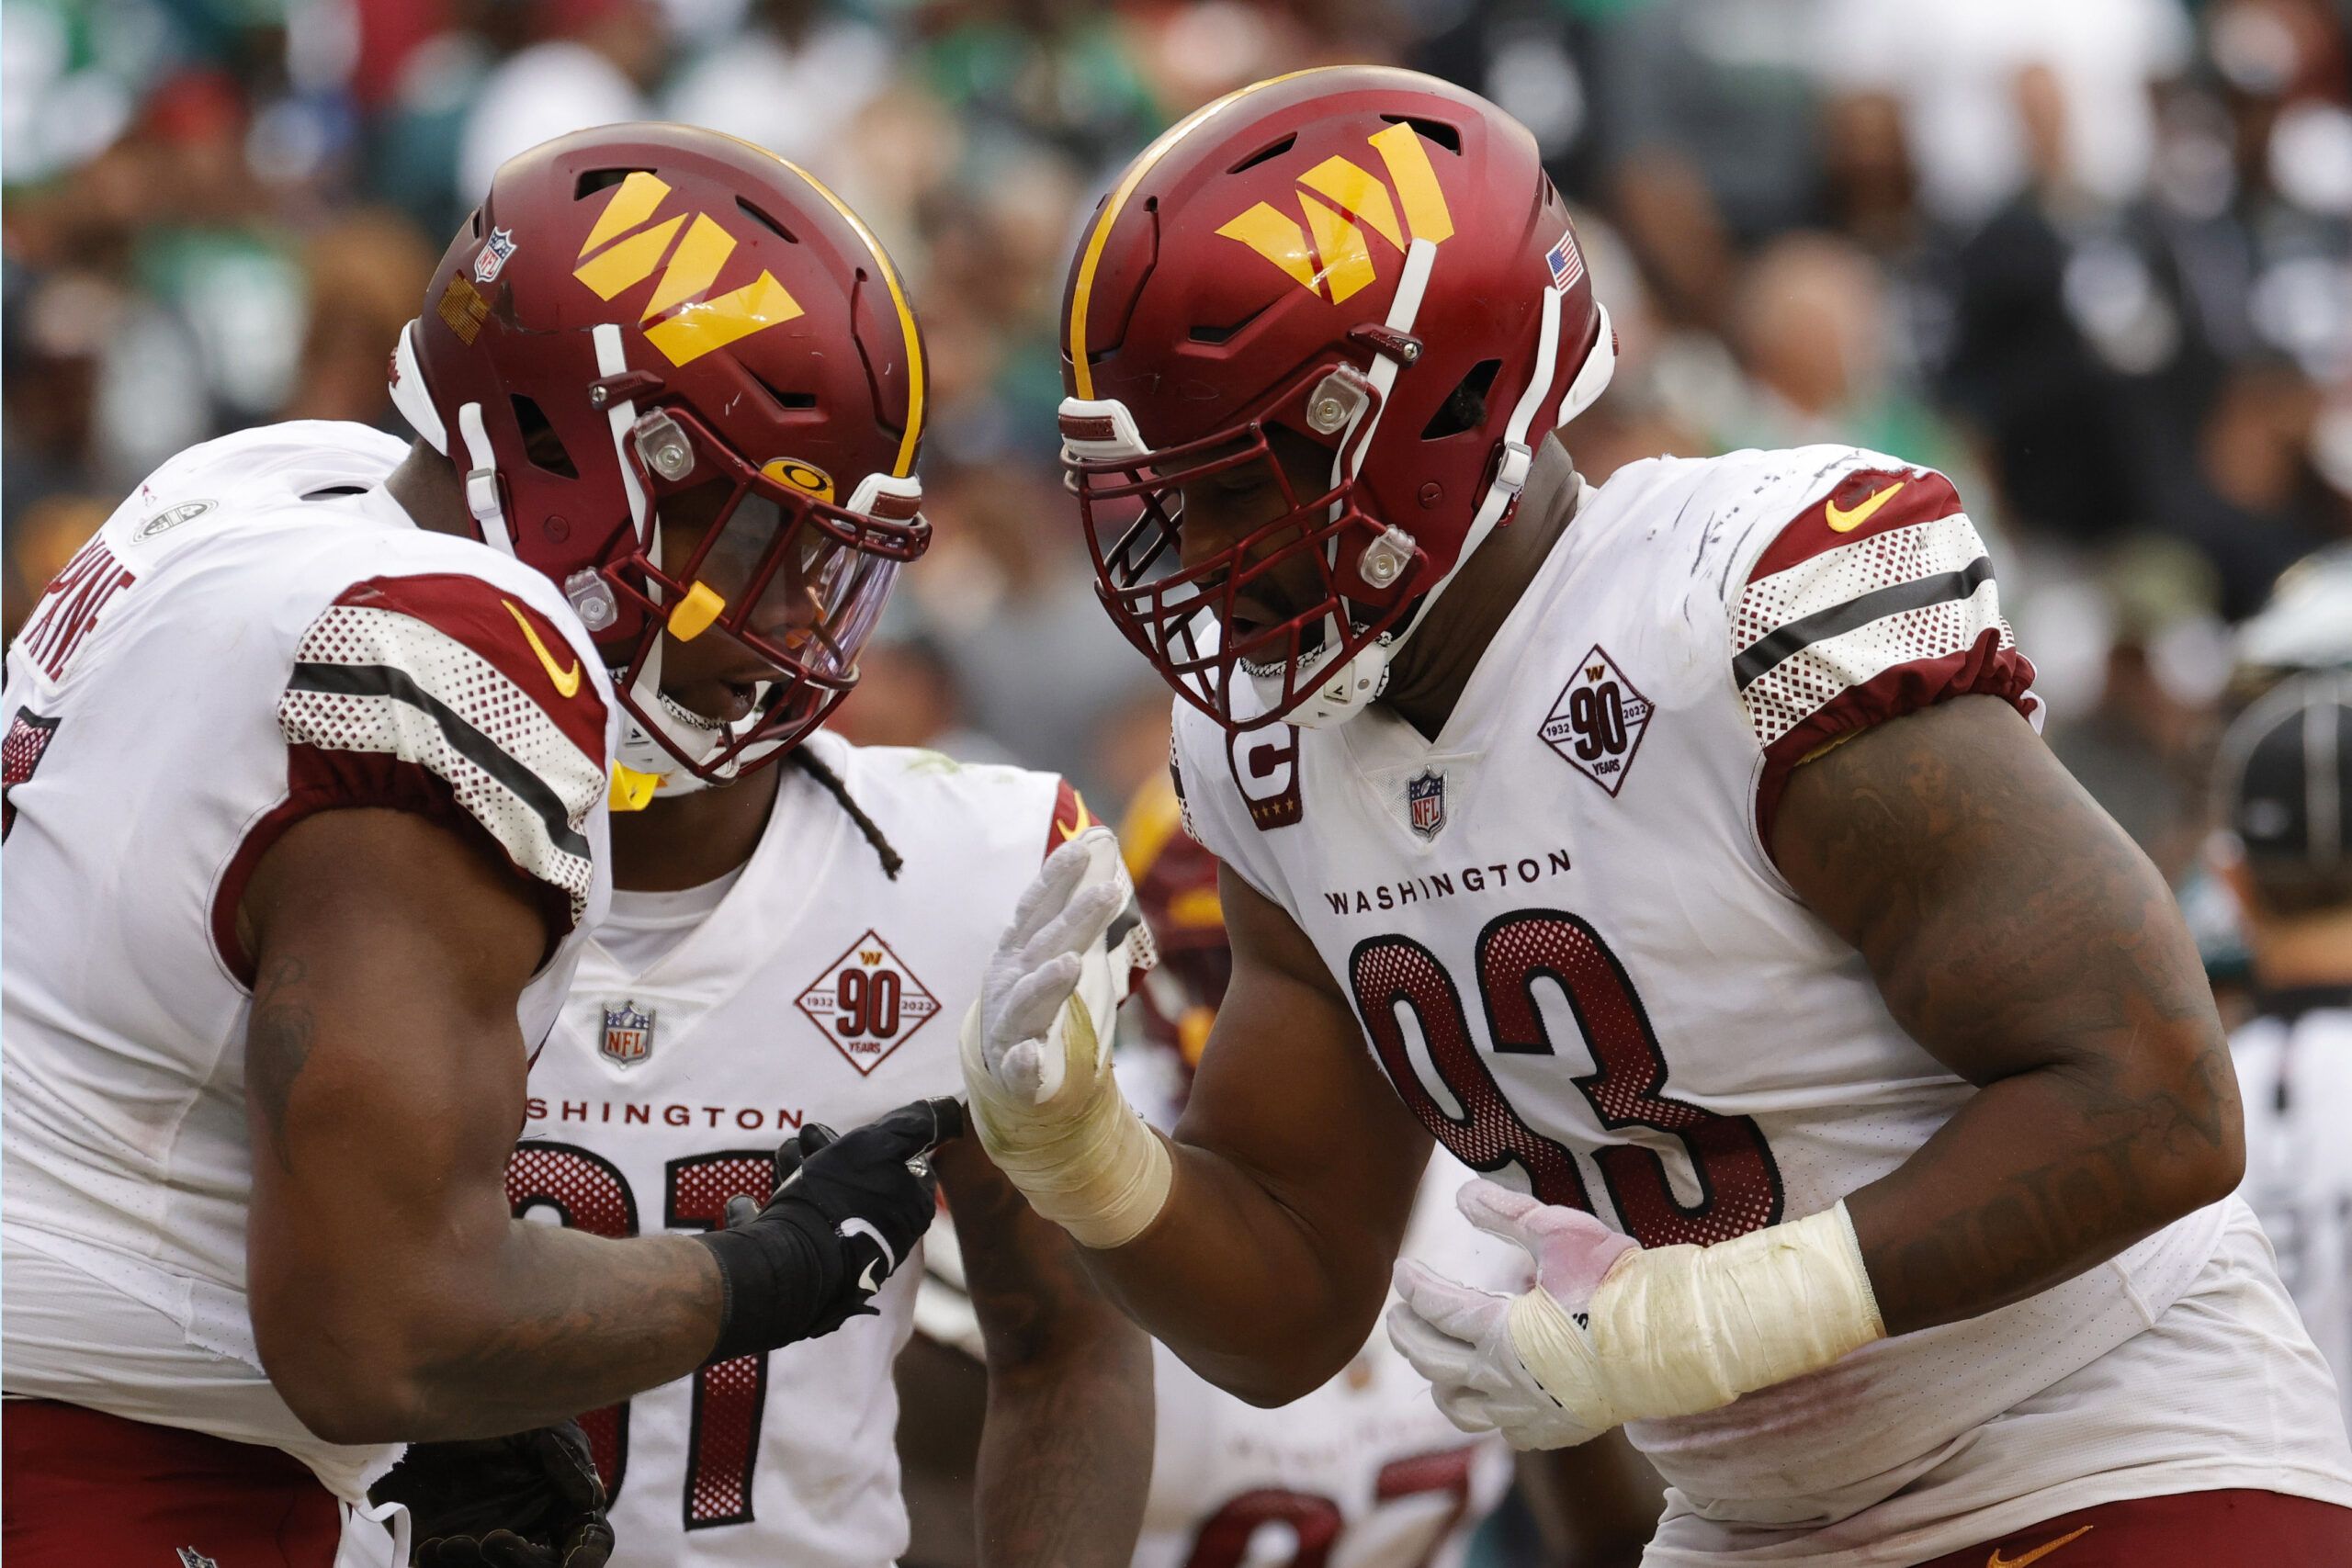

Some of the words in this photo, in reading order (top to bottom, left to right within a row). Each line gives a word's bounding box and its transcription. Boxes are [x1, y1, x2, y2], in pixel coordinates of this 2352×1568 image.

[478, 249, 498, 276] NFL
[1569, 681, 1628, 761] 90
[1623, 704, 1647, 719] 2022
[1546, 723, 1570, 737] 1932
[1232, 721, 1292, 801] C
[1591, 759, 1621, 776] YEARS
[1413, 797, 1440, 826] NFL
[1324, 849, 1572, 915] WASHINGTON
[807, 997, 833, 1008] 1932
[836, 968, 901, 1039] 90
[901, 1000, 933, 1010] 2022
[606, 1030, 645, 1057] NFL
[849, 1042, 881, 1054] YEARS
[1348, 907, 1785, 1250] 93
[526, 1098, 803, 1130] SHINGTON
